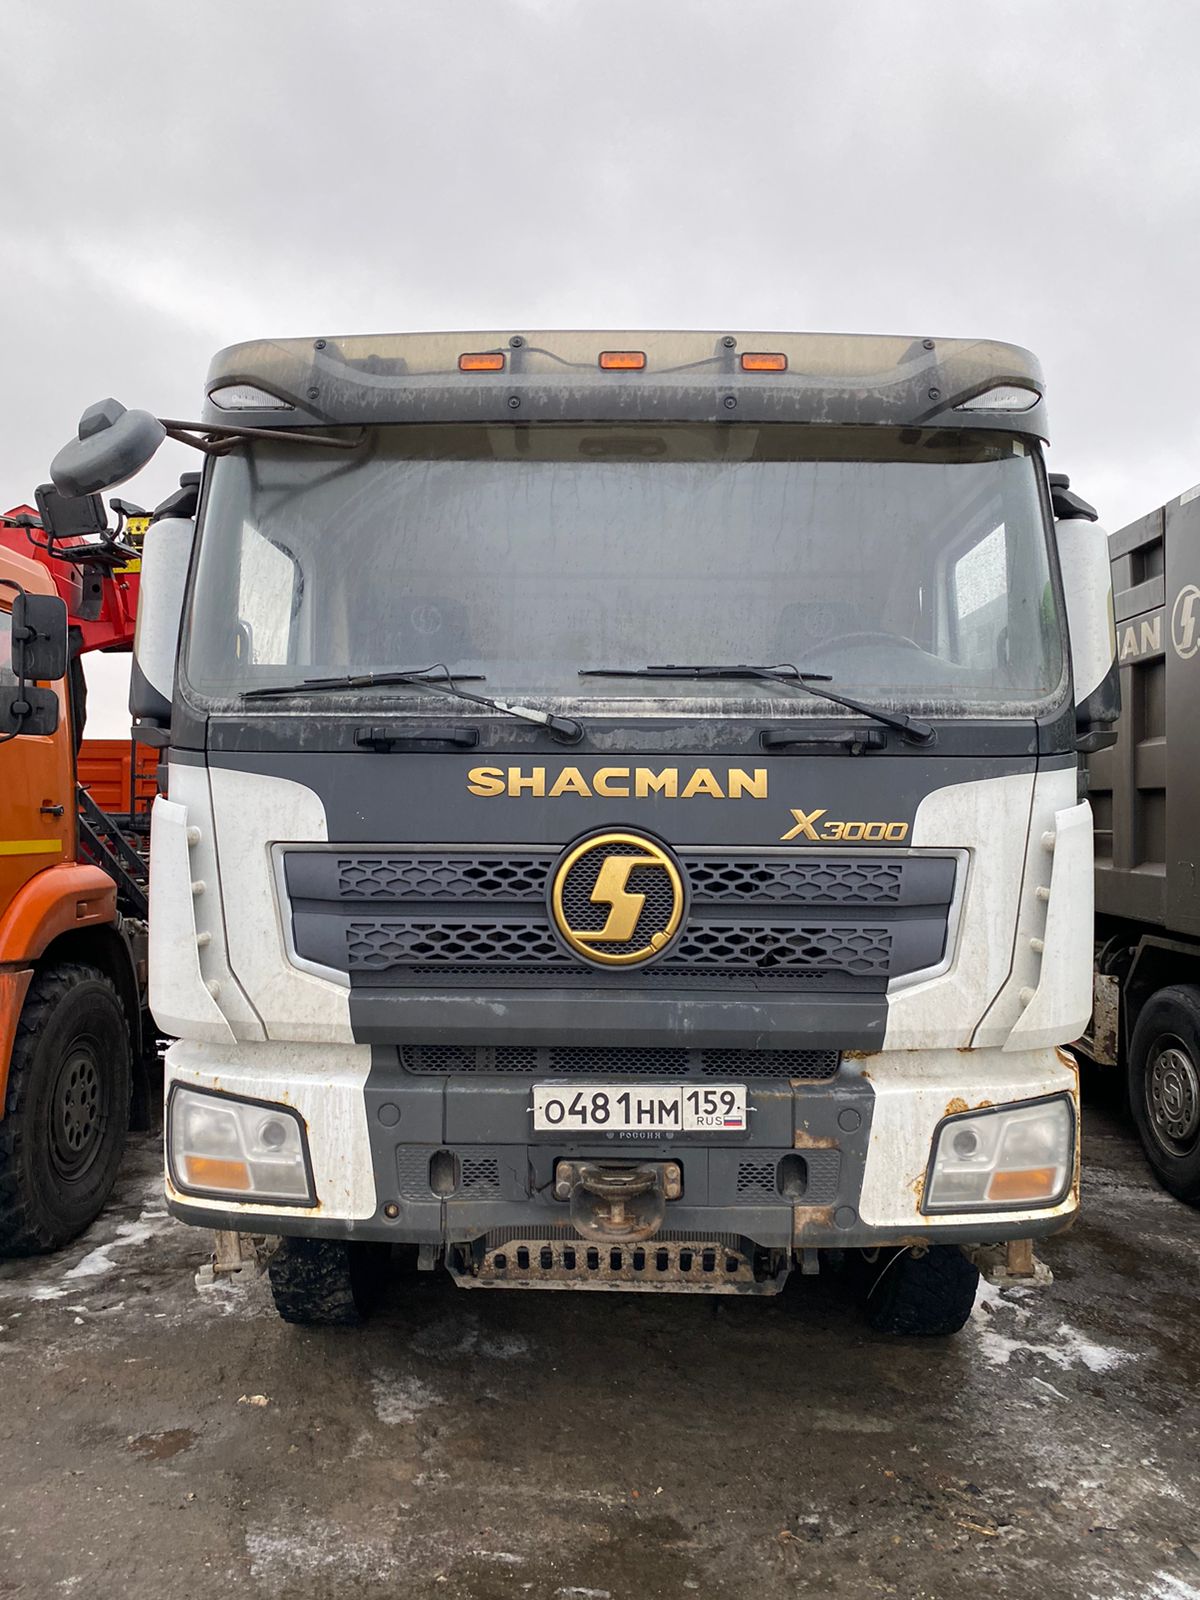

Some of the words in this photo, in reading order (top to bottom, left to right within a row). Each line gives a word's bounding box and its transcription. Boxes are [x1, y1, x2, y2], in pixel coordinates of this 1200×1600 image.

[1116, 615, 1161, 661] AN
[467, 766, 768, 798] SHACMAN
[780, 808, 909, 842] X3000
[686, 1090, 736, 1115] 159
[697, 1116, 723, 1126] RUS
